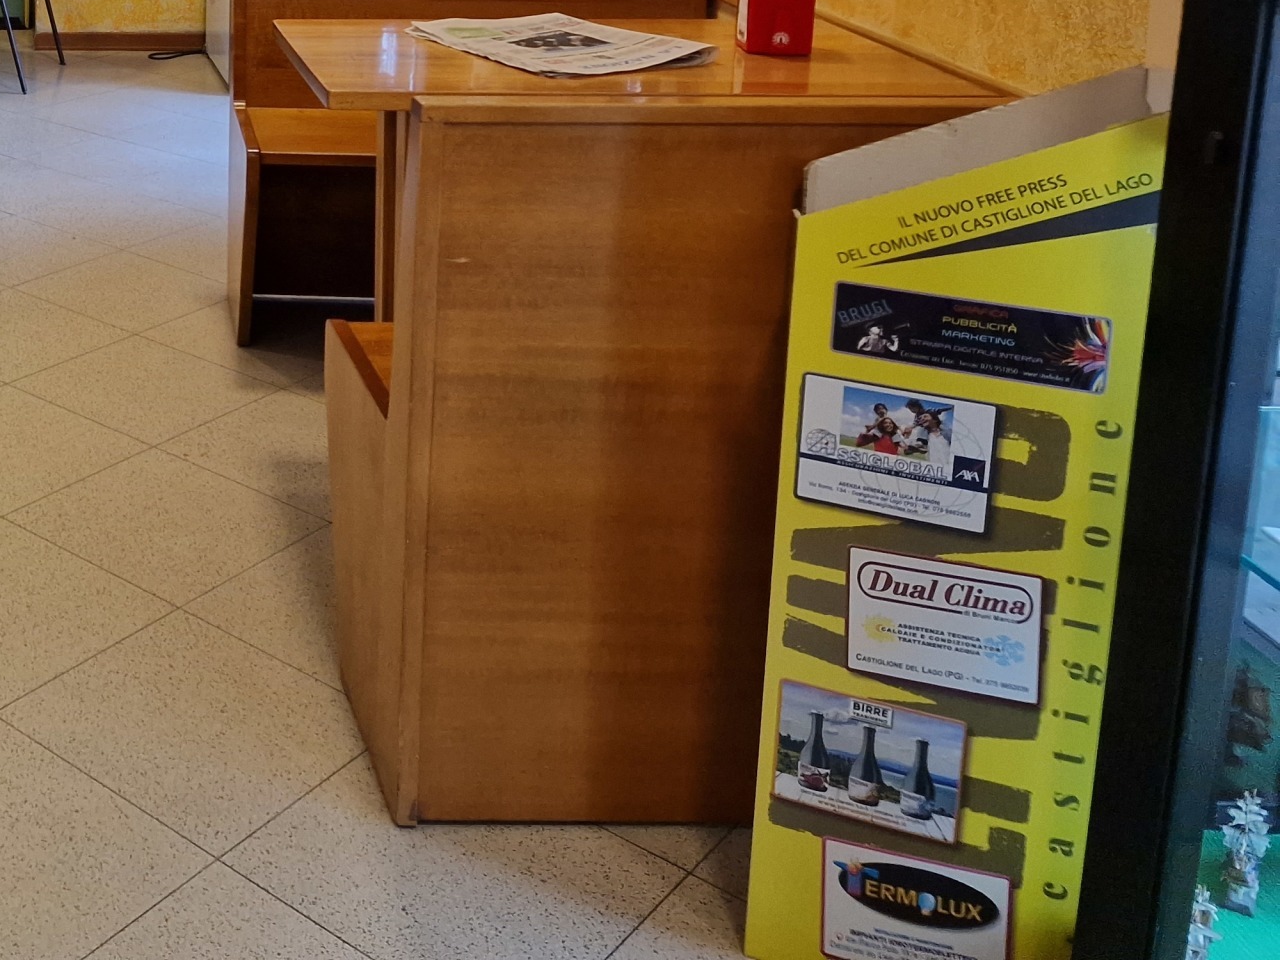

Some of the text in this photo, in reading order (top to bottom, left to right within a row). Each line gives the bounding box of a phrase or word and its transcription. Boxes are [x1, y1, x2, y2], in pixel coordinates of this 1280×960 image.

[898, 173, 1068, 229] IL NUOVO FREE PRESS
[836, 172, 1154, 265] DEL COMUNE DI CASTIGLIONE DEL LAGO
[942, 316, 1018, 334] PUBBLICITÀ
[941, 329, 1016, 347] MARKETING
[910, 339, 952, 351] STAMPA
[952, 345, 997, 358] DIGITALE
[807, 432, 948, 481] ASSIGLOBAL
[954, 469, 980, 482] AXA
[839, 481, 861, 490] AGENZIA
[863, 485, 890, 496] GENERALE
[868, 569, 1027, 616] Dual Clima
[880, 626, 918, 638] CALDAIE
[898, 623, 982, 642] ASSISTENZA TECNICA
[898, 636, 982, 657] TRATTAMENTO ACQUA
[1042, 419, 1124, 901] castiglione
[944, 669, 964, 681] (PG)
[852, 701, 889, 719] BIRRE
